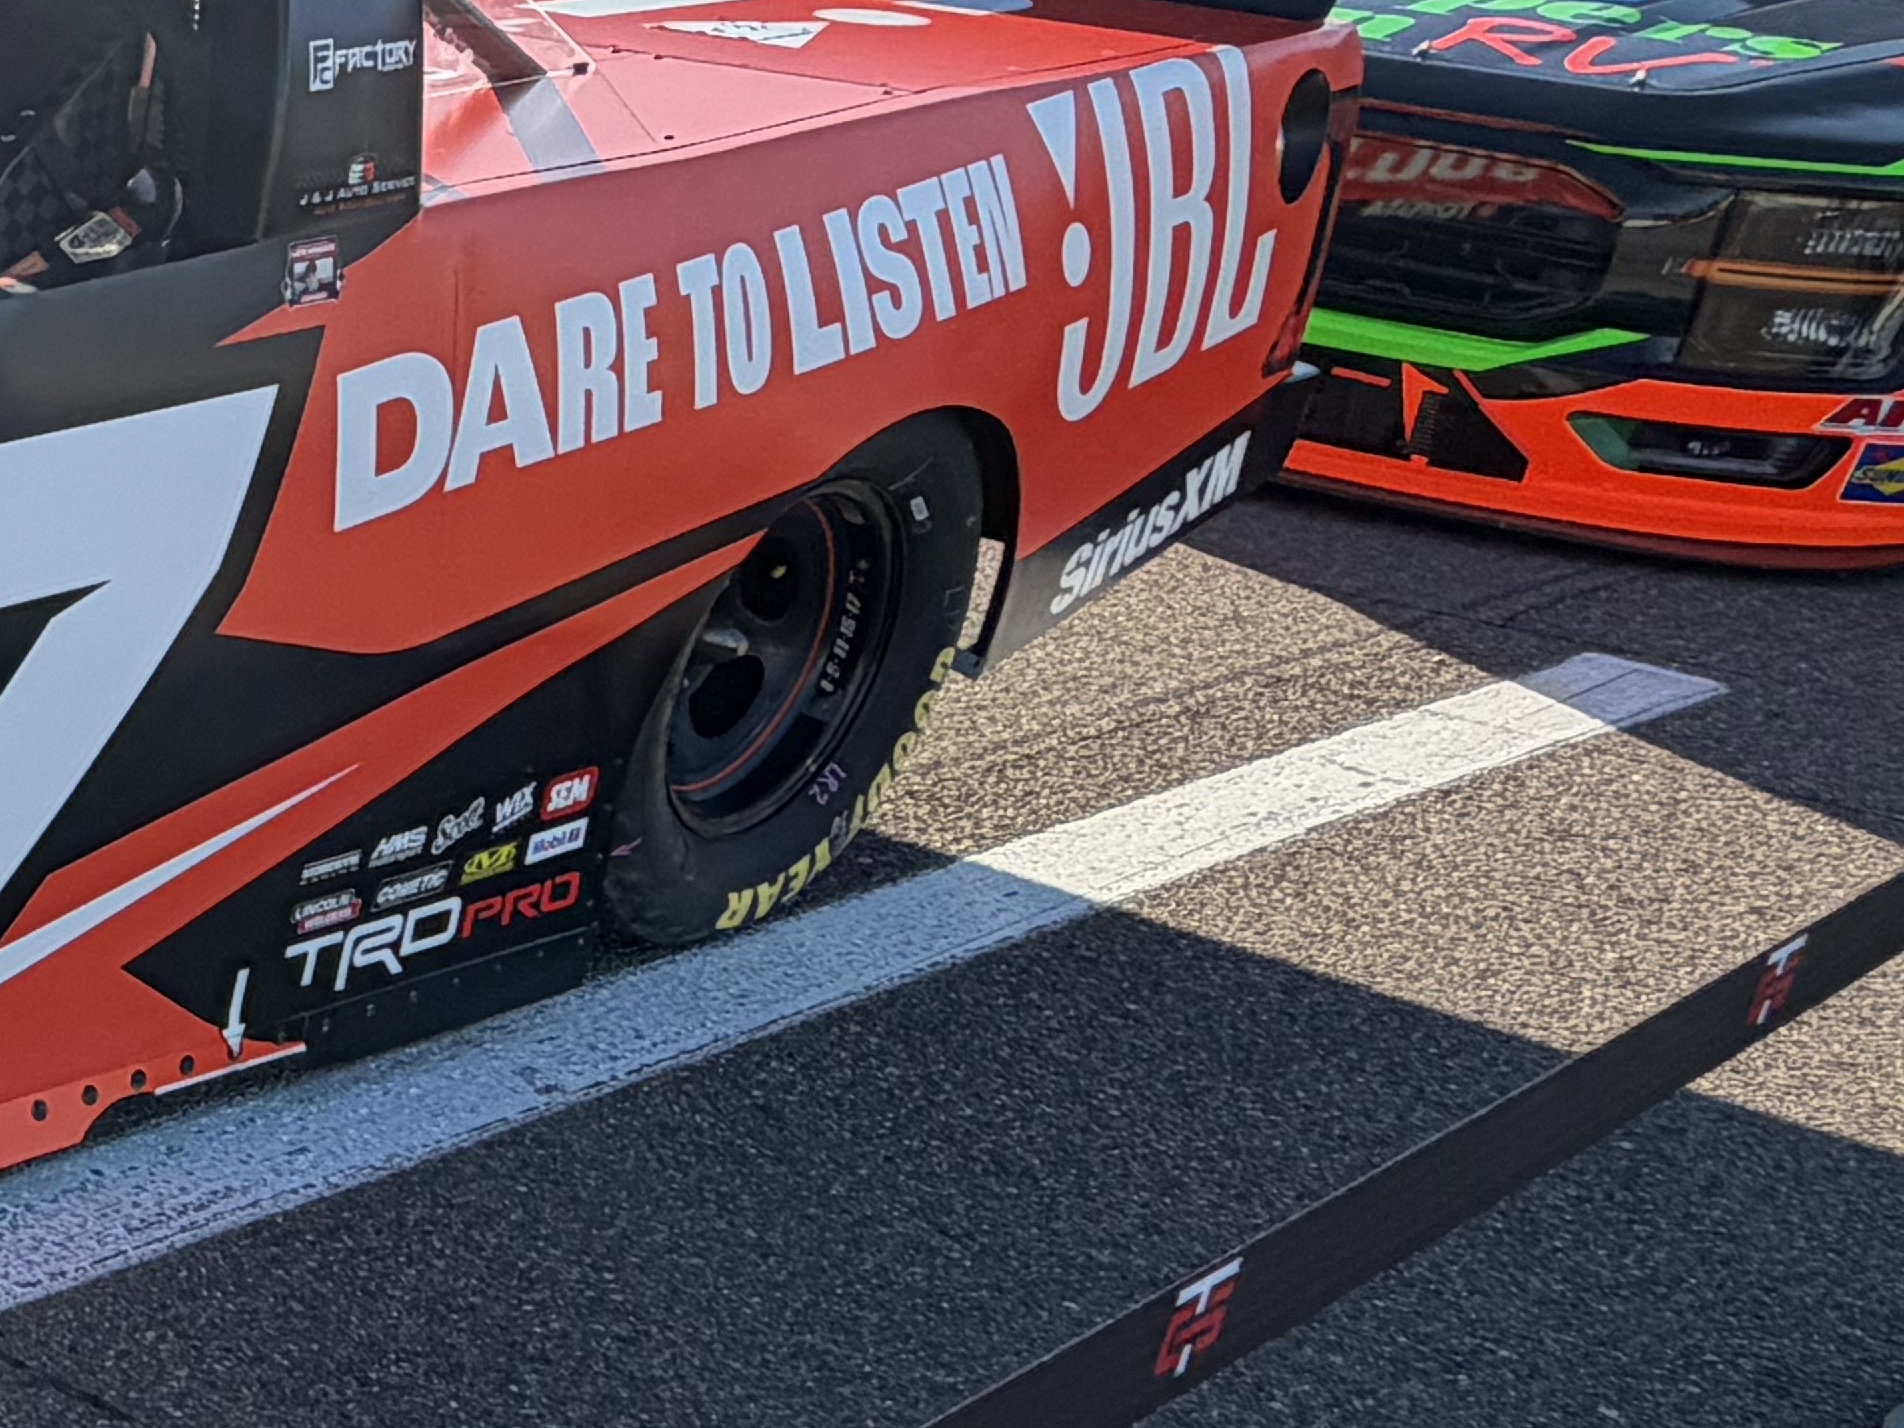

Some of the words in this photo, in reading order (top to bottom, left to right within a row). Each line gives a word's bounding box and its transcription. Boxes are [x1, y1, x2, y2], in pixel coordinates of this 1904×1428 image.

[334, 274, 664, 532] DARE
[676, 241, 771, 408] TO
[773, 154, 1029, 375] LISTEN
[1056, 44, 1278, 422] JBL
[1049, 429, 1252, 616] SiriusXM
[284, 896, 462, 992] TRD
[461, 871, 582, 939] PRO
